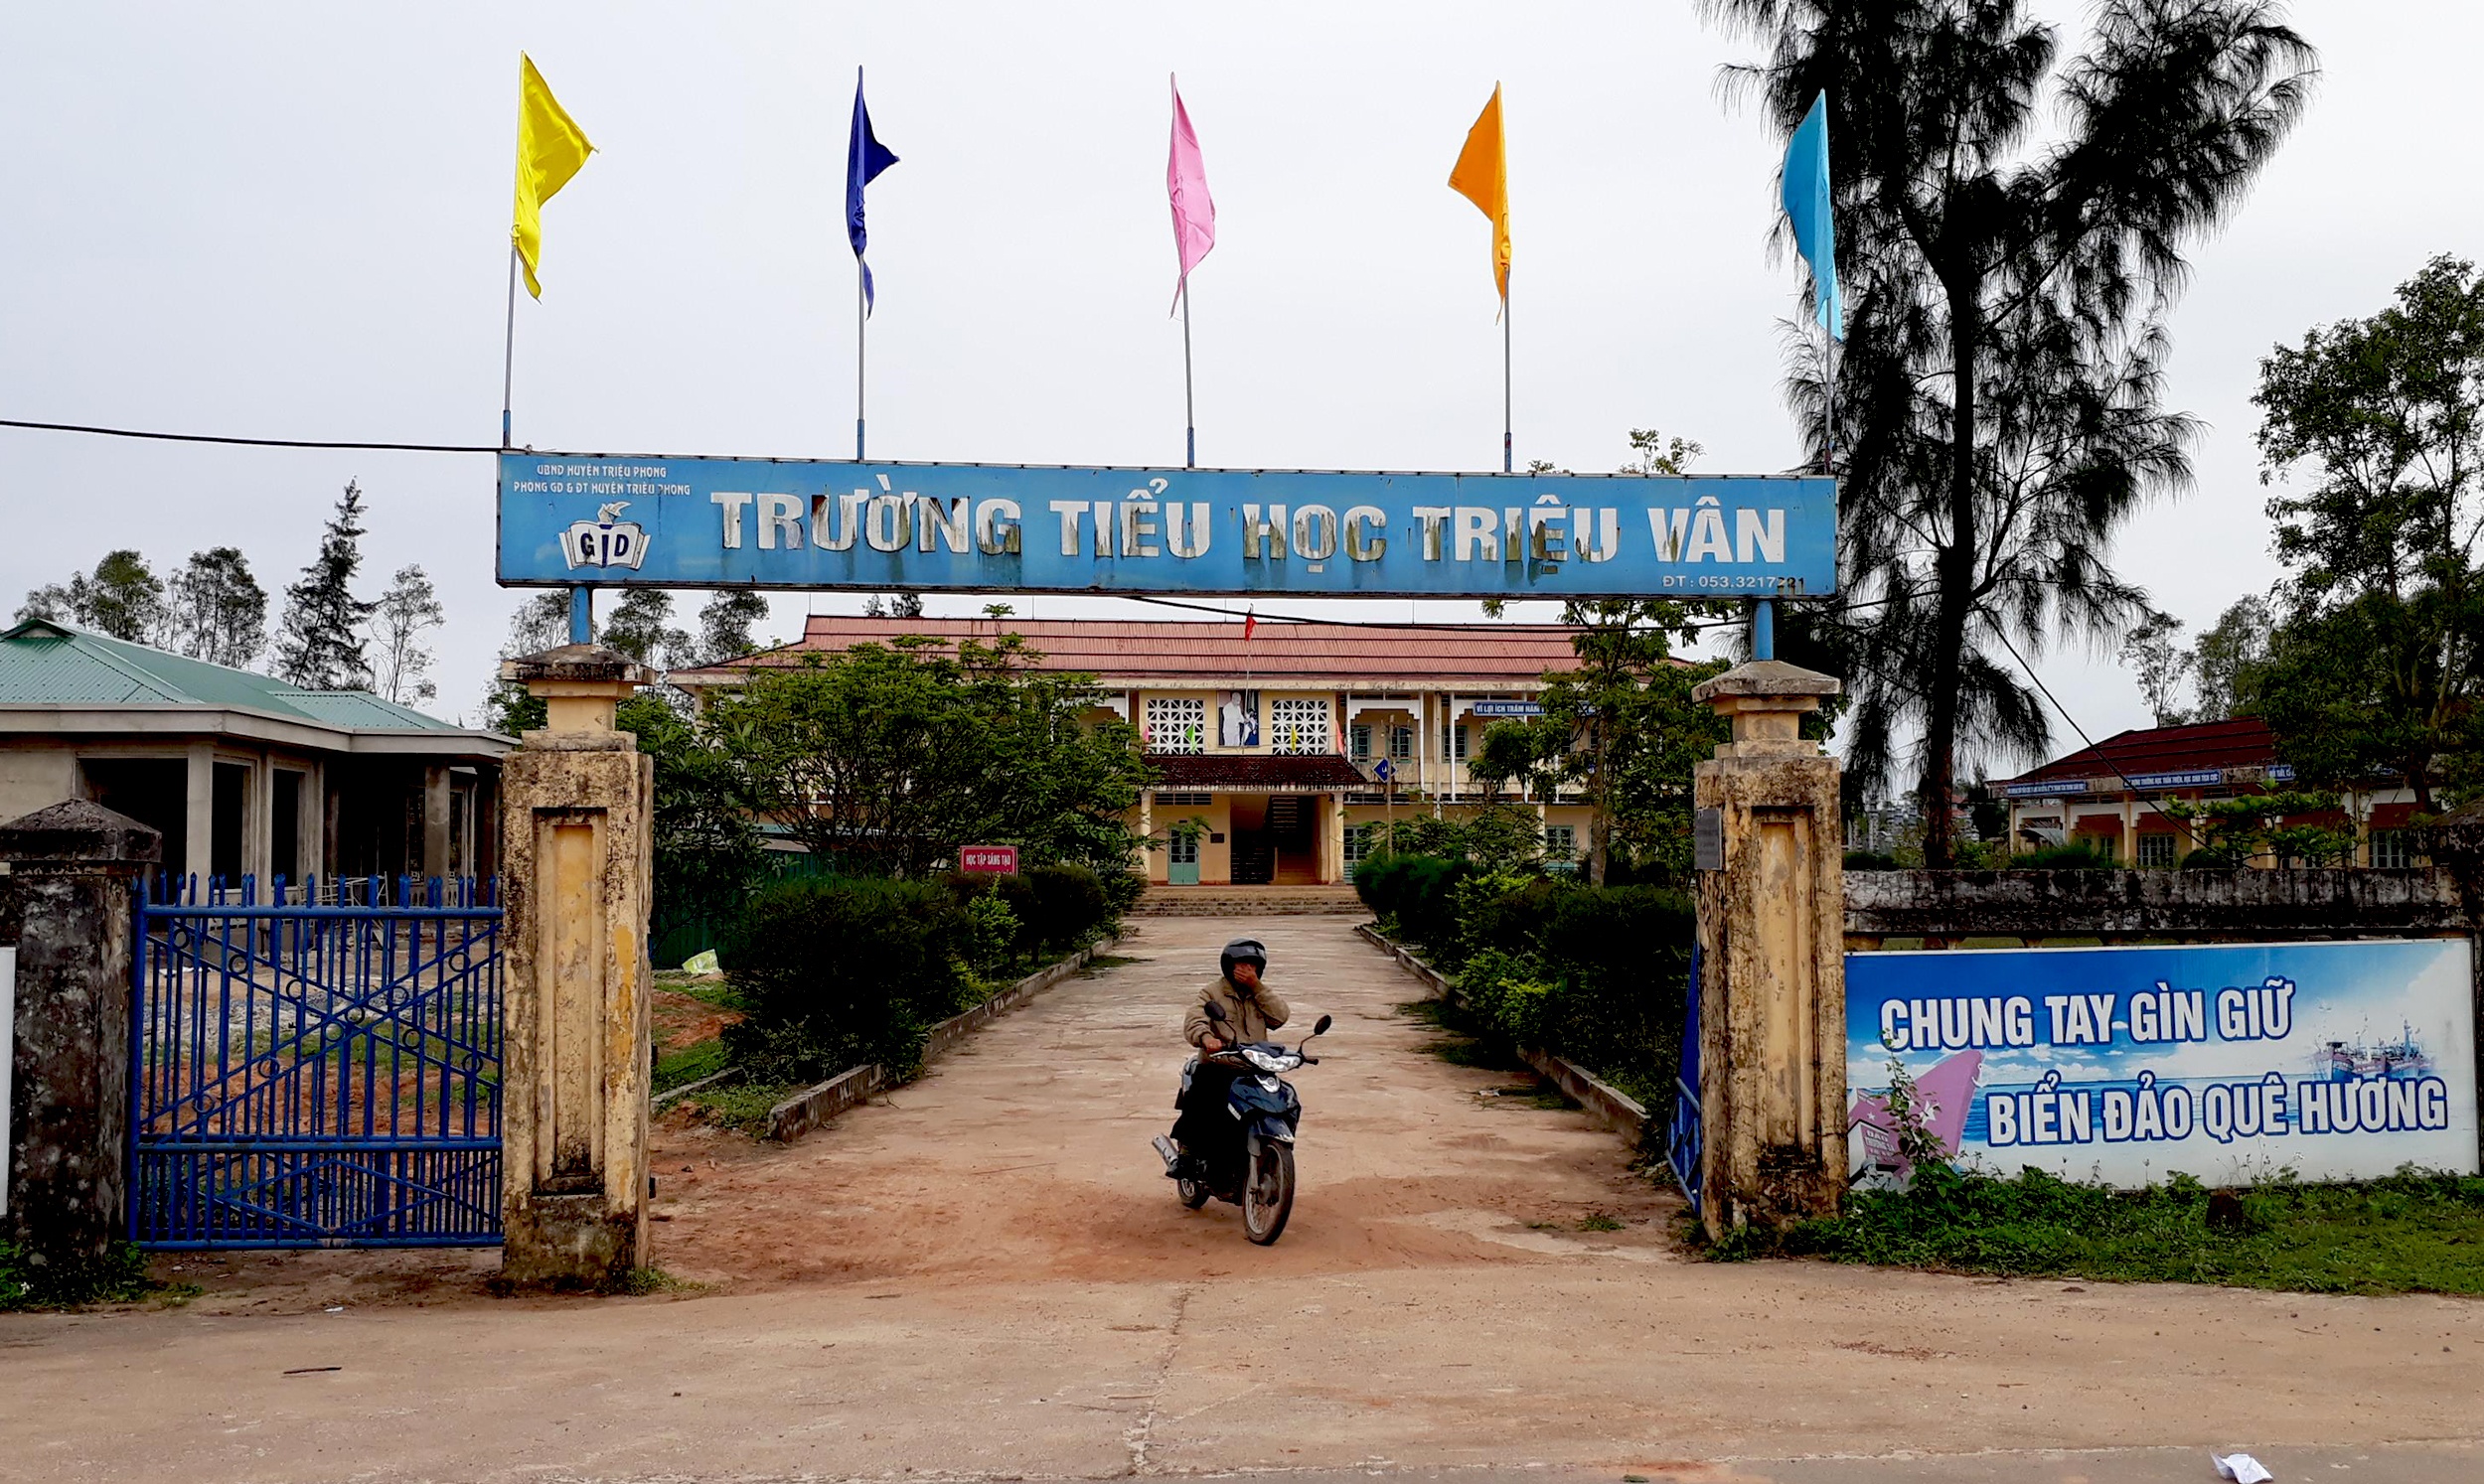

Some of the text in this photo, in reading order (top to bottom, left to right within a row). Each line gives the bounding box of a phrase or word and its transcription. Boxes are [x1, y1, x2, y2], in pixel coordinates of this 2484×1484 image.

[537, 463, 667, 479] UBND HUYỆN TRIỆU PHONG
[550, 482, 563, 494] GD
[566, 483, 573, 494] &
[575, 483, 588, 494] ĐT
[591, 481, 624, 497] HUYỆN
[709, 474, 1785, 574] TRƯỜNG TIỂU HỌC TRIỆU VÂN
[1880, 976, 2295, 1050] CHUNG TAY GÌN GIỮ
[1987, 1071, 2448, 1145] BIỂN ĐẢO QUÊ HƯƠNG
